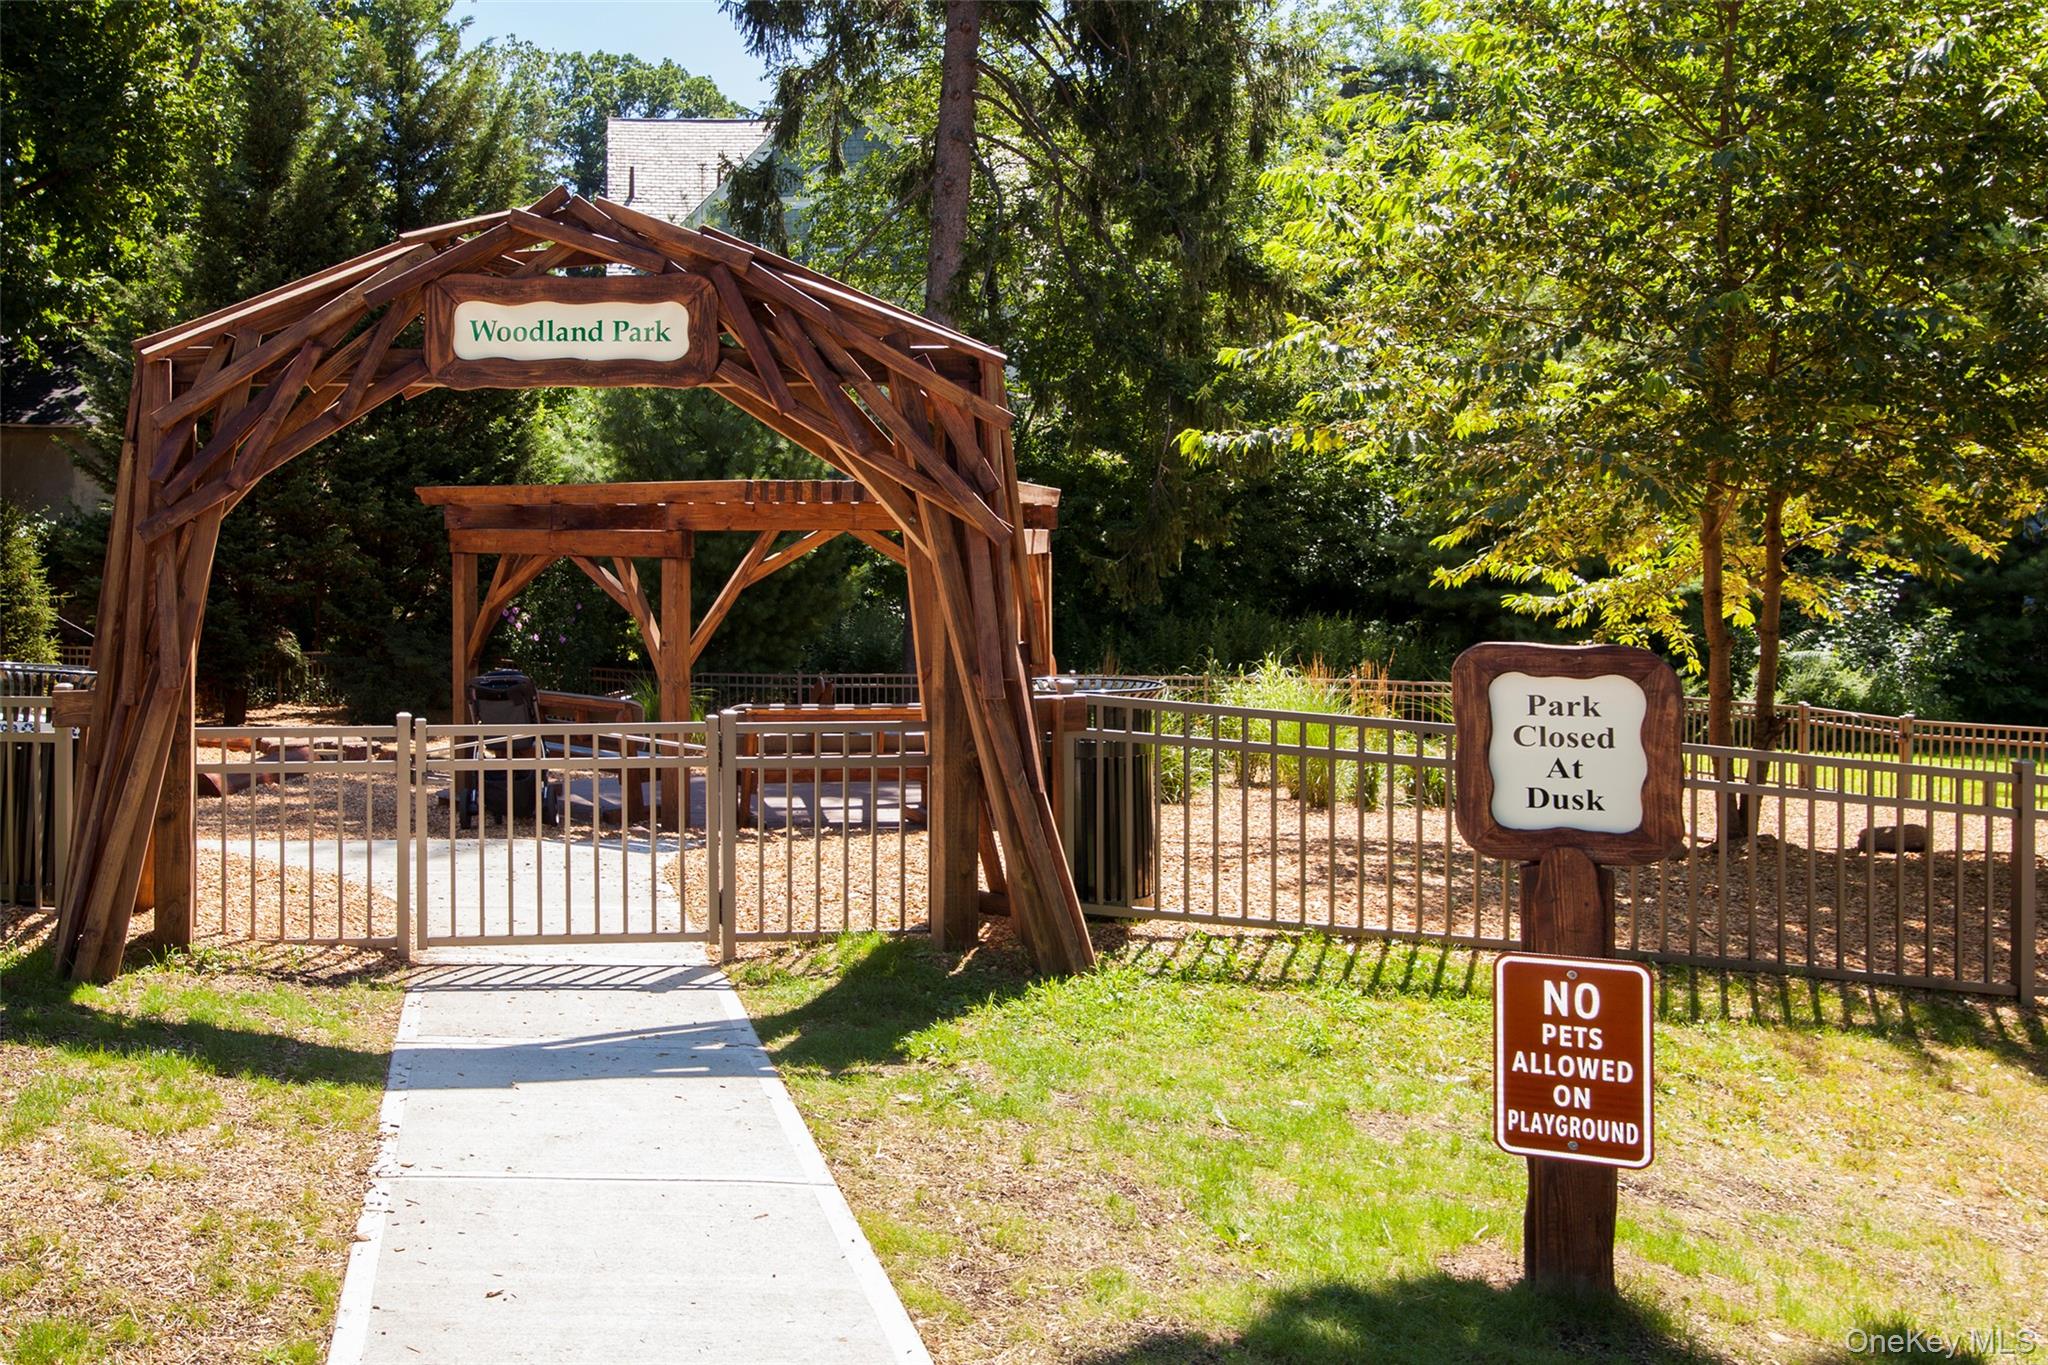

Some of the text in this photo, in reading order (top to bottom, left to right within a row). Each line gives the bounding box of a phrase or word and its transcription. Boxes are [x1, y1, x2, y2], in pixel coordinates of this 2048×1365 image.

[469, 319, 672, 343] Woodland Park
[1527, 694, 1601, 717] Park
[1513, 724, 1615, 749] Closed
[1546, 757, 1584, 779] At
[1526, 787, 1606, 811] Dusk
[1543, 979, 1600, 1020] NO
[1541, 1023, 1603, 1050] PETS
[1511, 1050, 1634, 1084] ALLOWED
[1553, 1084, 1591, 1110] ON
[1507, 1108, 1639, 1145] PLAYGROUND
